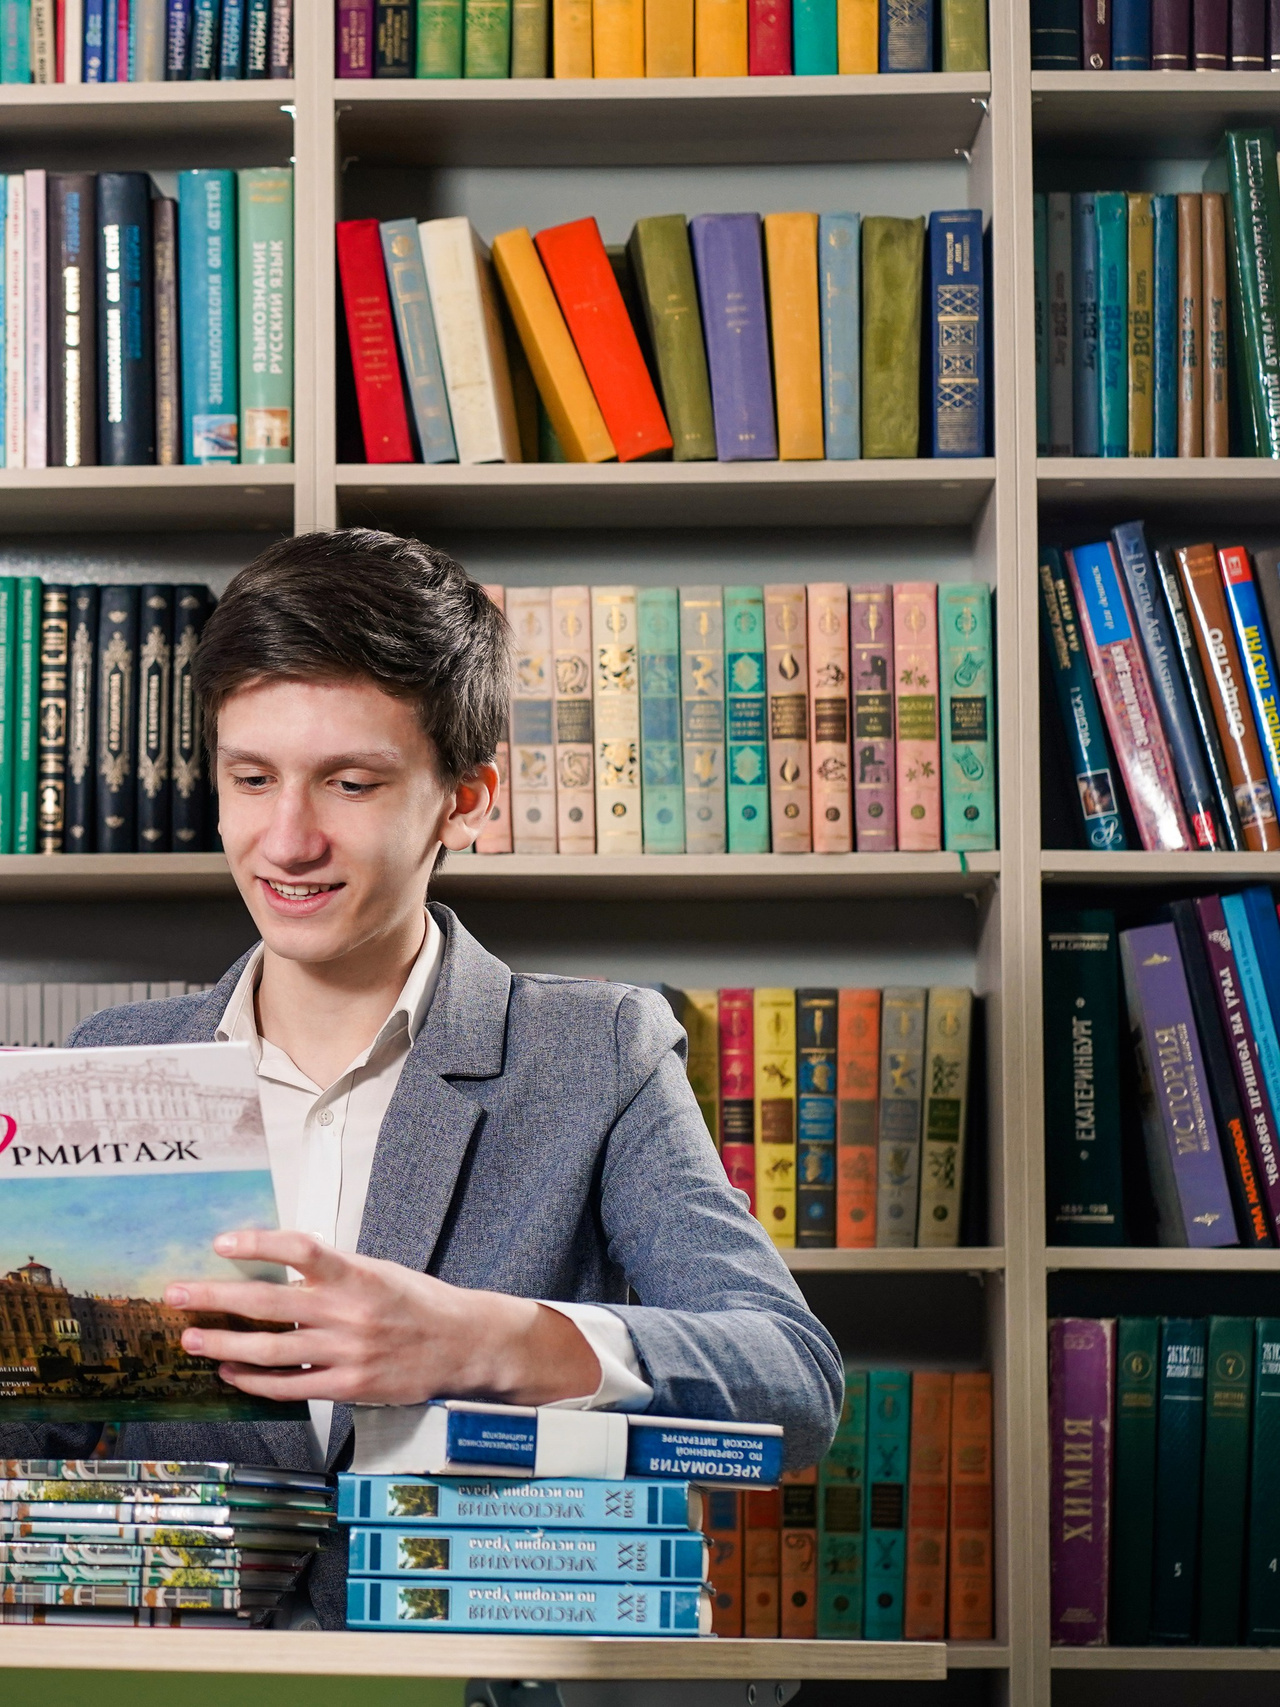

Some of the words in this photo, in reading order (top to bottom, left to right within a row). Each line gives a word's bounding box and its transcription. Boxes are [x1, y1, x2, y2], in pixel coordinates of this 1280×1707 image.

[1245, 138, 1267, 211] РОССИИ
[205, 180, 220, 229] ДЕТЕЙ
[207, 235, 222, 268] ДЛЯ
[268, 239, 284, 288] ЯЗЫК
[252, 240, 266, 373] ЯЗЫКОЗНАНИЕ
[207, 273, 223, 404] ЭНЦИКЛОПЕДИЯ
[265, 292, 284, 374] РУССКИЙ
[1101, 304, 1121, 352] ВСЁ
[1127, 310, 1150, 357] ВСЁ
[1145, 614, 1164, 643] ART
[1243, 623, 1272, 691] НАУКИ
[1202, 625, 1250, 740] ОБЩЕСТВО
[1218, 965, 1240, 1009] УРАЛ
[1229, 1012, 1244, 1037] НА
[1073, 1016, 1096, 1142] ЕКАТЕРИНБУРГ
[1235, 1038, 1263, 1110] ПРИШЕЛ
[1154, 1026, 1199, 1156] ИСТОРИЯ
[1227, 1118, 1259, 1204] МАСТЕРОВОЙ
[1253, 1112, 1280, 1186] ЧЕЛОВЕК
[1248, 1204, 1268, 1240] УРАЛ
[457, 1438, 521, 1450] СТАРШЕКЛАССНИКОВ
[482, 1431, 527, 1441] АБИТУРИЕНТОВ
[521, 1442, 534, 1451] ДЛЯ
[662, 1434, 719, 1447] ЛИТЕРАТУРЕ
[723, 1438, 763, 1449] РУССКОЙ
[676, 1446, 744, 1460] СОВРЕМЕННОЙ
[749, 1451, 763, 1461] ПО
[650, 1457, 762, 1479] ХРЕСТОМАТИЯ
[1063, 1418, 1093, 1542] ХИМИЯ
[458, 1486, 499, 1500] Урала
[503, 1487, 562, 1498] истории
[566, 1489, 584, 1498] по
[624, 1489, 635, 1518] век
[458, 1502, 585, 1518] ХРЕСТОМАТИЯ
[470, 1536, 512, 1552] Урала
[515, 1538, 574, 1551] истории
[578, 1541, 596, 1551] по
[636, 1542, 647, 1572] век
[469, 1555, 597, 1572] ХРЕСТОМАТИЯ
[1173, 1562, 1183, 1578] 5
[1268, 1557, 1278, 1574] 4
[469, 1587, 511, 1603] Урала
[515, 1589, 574, 1602] истории
[578, 1592, 596, 1602] по
[636, 1593, 647, 1623] век
[469, 1605, 597, 1622] ХРЕСТОМАТИЯ
